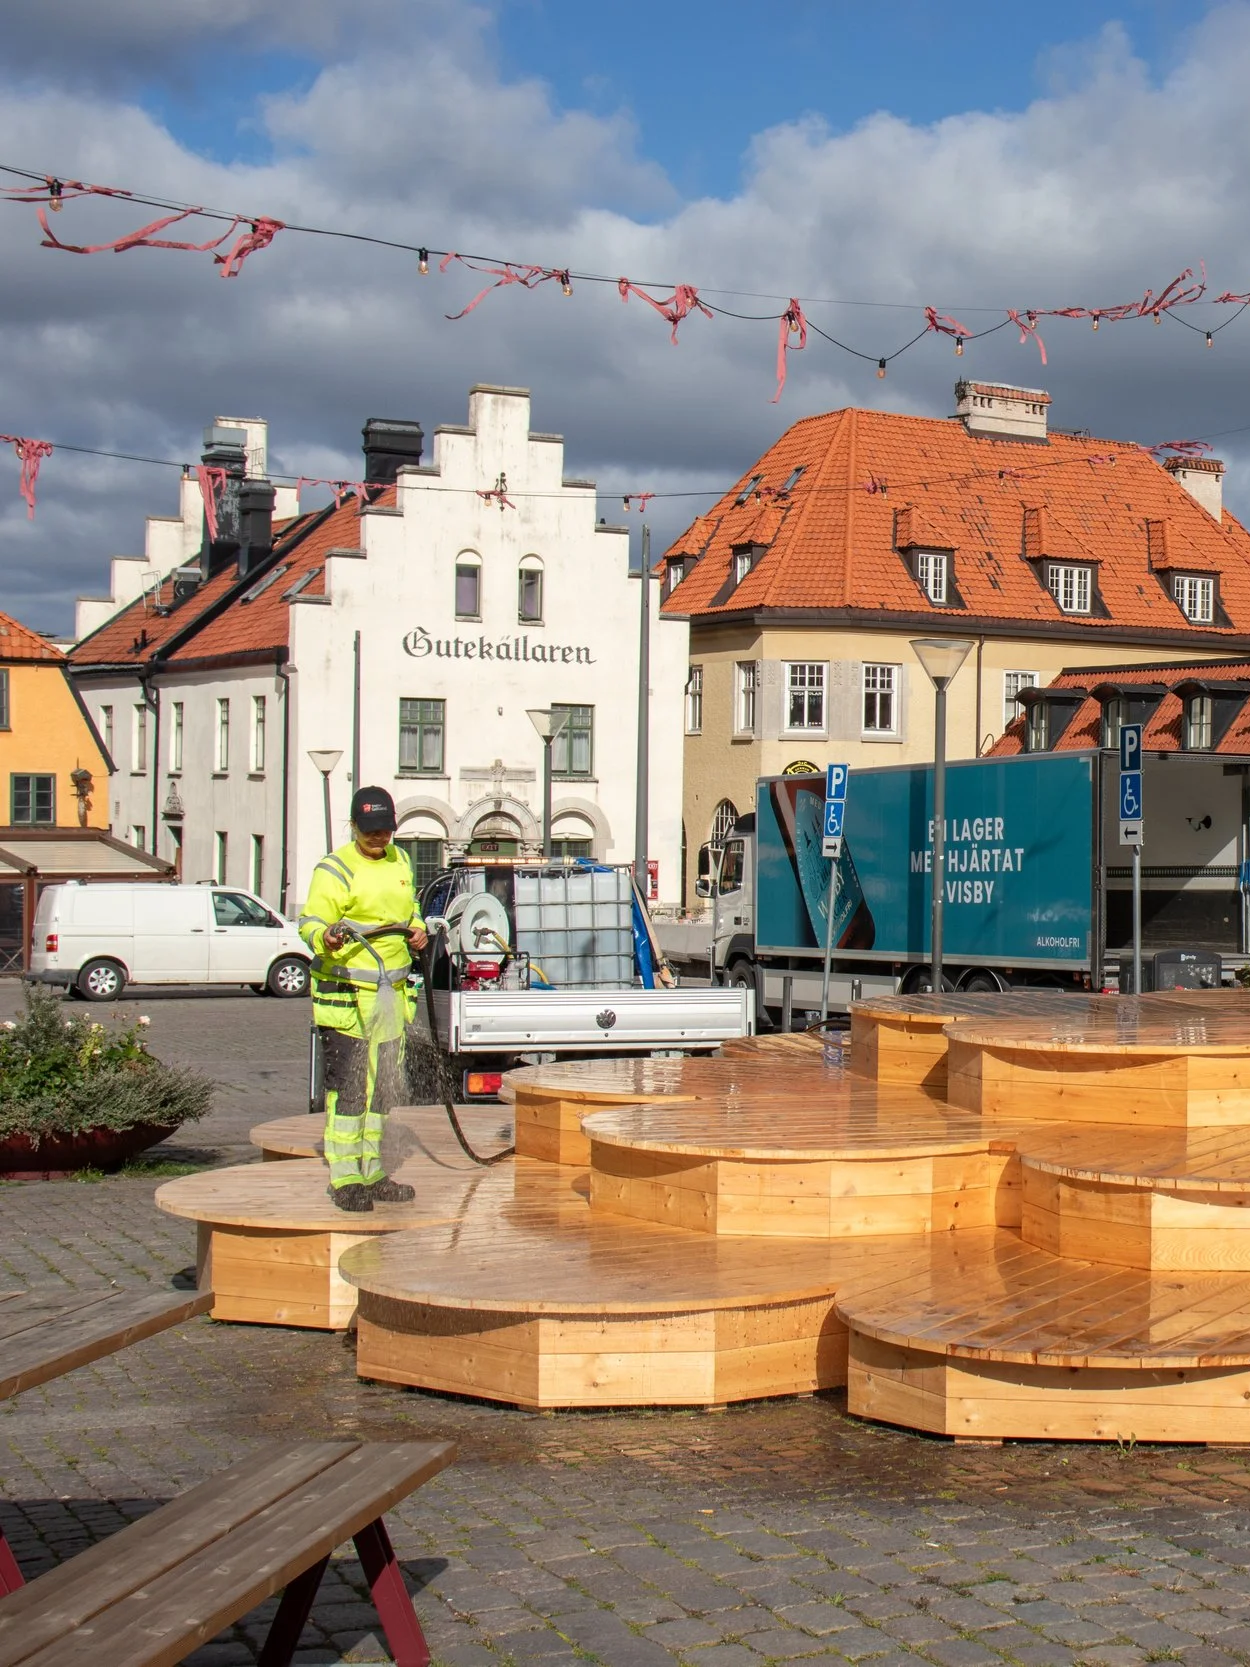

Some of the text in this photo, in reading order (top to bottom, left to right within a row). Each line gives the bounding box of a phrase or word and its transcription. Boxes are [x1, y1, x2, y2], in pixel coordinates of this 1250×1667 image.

[402, 626, 598, 665] Gutekällaren
[1125, 729, 1138, 768] P
[831, 767, 844, 797] P
[953, 817, 1004, 842] LAGER
[911, 843, 1024, 873] ME HJÄRTAT
[946, 880, 995, 904] VISBY
[1036, 936, 1080, 948] ALKOHOLFRI
